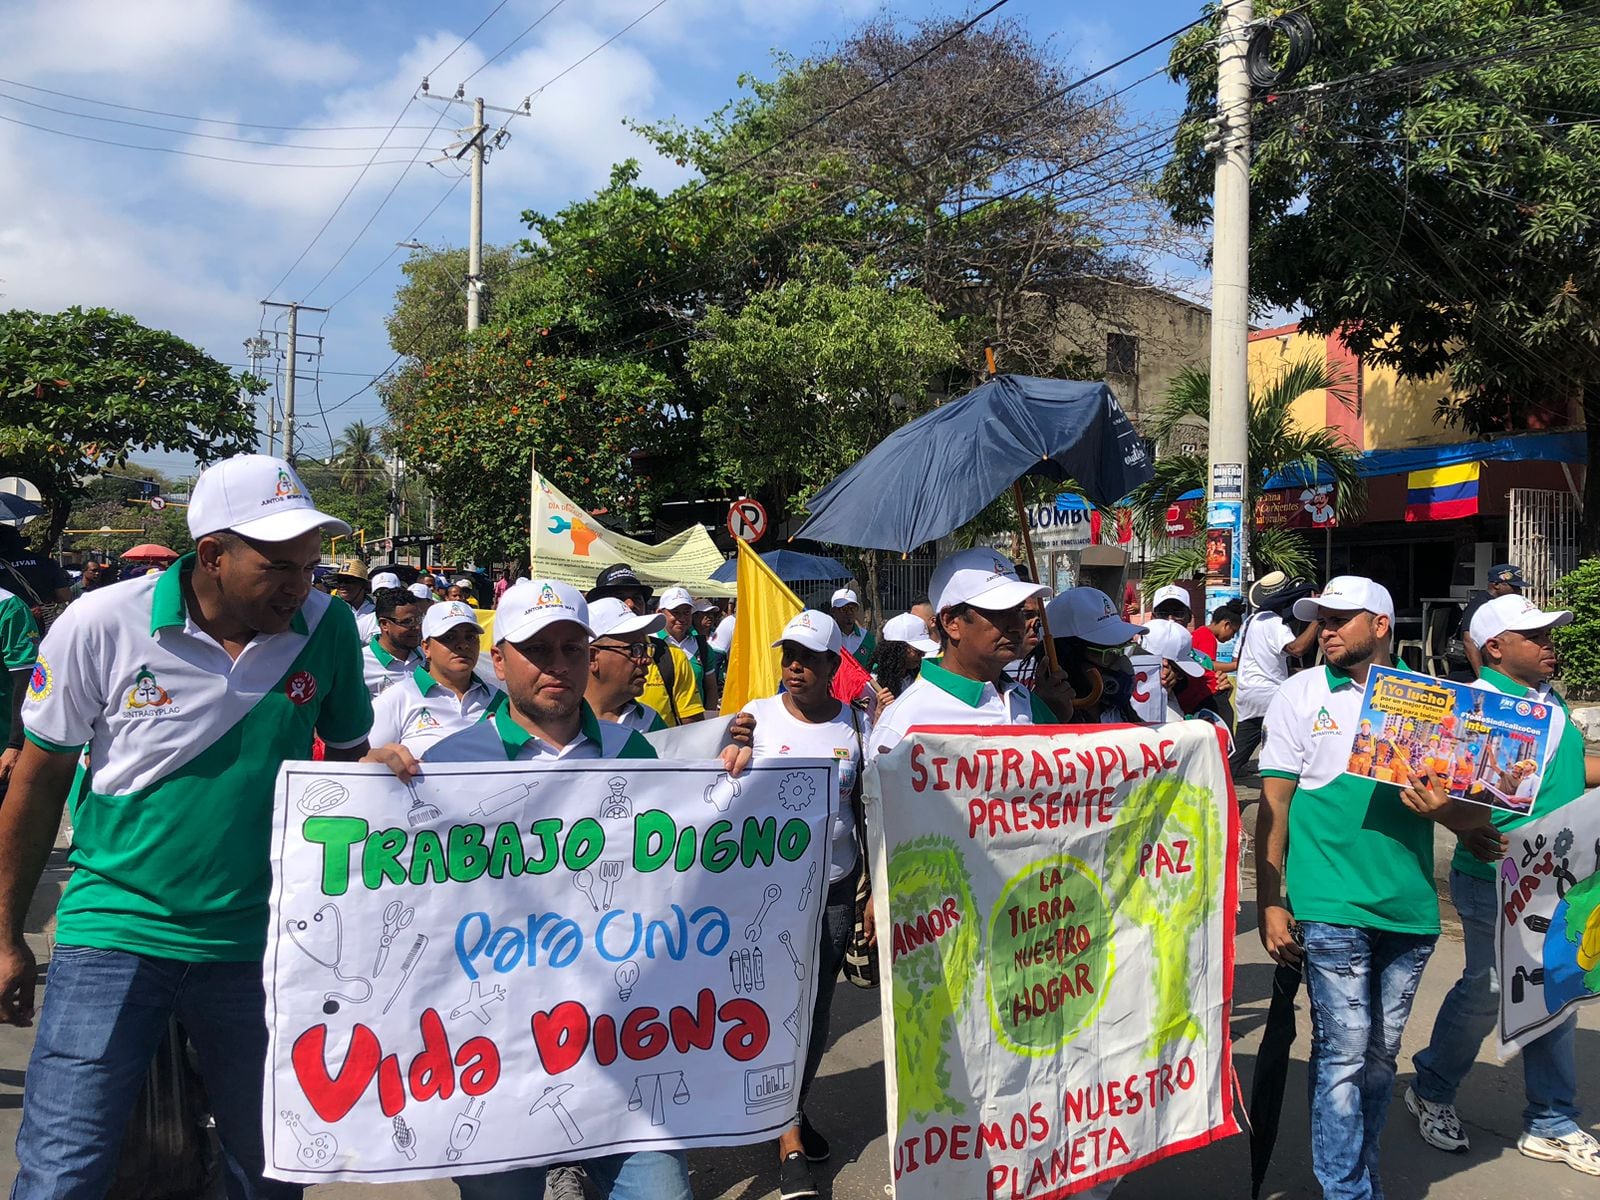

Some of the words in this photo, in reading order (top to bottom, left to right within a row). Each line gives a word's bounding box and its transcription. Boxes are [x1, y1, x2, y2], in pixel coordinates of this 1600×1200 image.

[1214, 467, 1241, 476] DINERO
[122, 707, 180, 718] SINTRAGYPLAC
[1379, 703, 1402, 713] laboral
[1407, 689, 1446, 706] lucho
[911, 739, 1178, 793] SINTRAGYPLAC
[968, 787, 1115, 839] PRESENTE
[302, 810, 605, 896] TRABAJO
[632, 809, 811, 872] DIGNO
[1139, 840, 1193, 878] PAZ
[1522, 833, 1547, 868] de
[1039, 868, 1064, 892] LA
[892, 897, 961, 964] AMOR
[1008, 895, 1076, 939] TIERRA
[1014, 924, 1091, 973] NUESTRO
[1012, 963, 1094, 1027] HOGAR
[291, 1007, 502, 1124] Vida
[1065, 1056, 1197, 1126] NUESTRO
[987, 1126, 1131, 1200] PLANETA
